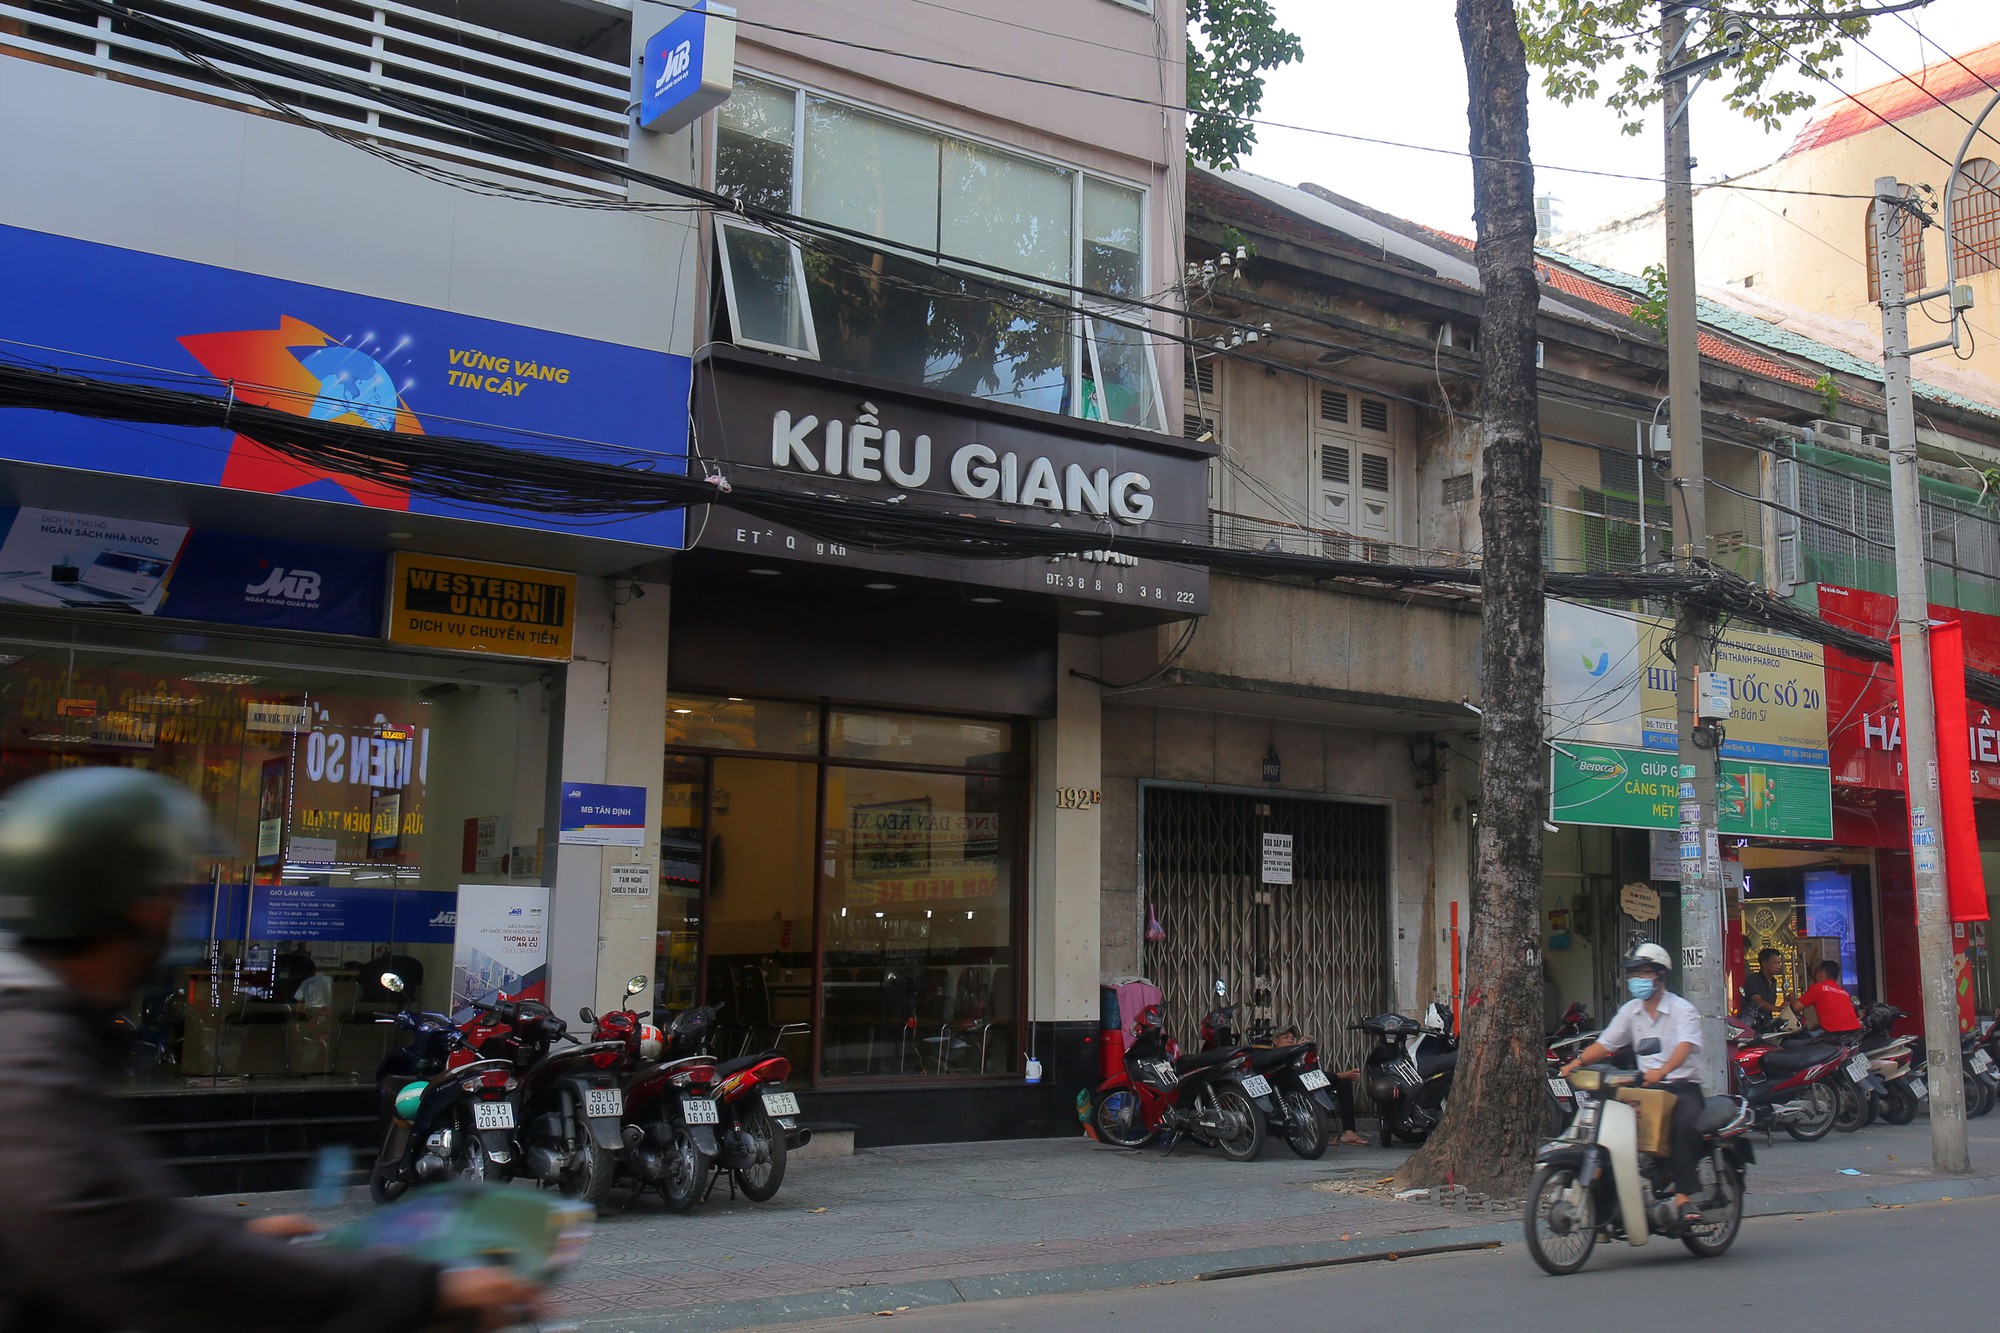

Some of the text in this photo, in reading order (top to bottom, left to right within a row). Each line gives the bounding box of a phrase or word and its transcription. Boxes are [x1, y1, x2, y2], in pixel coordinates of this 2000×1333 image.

[656, 40, 691, 89] MB
[449, 349, 570, 384] VỮNG VÀNG
[448, 370, 528, 396] TIN CẬY
[772, 401, 1155, 525] KIỀU GIANG
[41, 515, 61, 524] DỊCH
[64, 518, 75, 526] VỤ
[40, 524, 160, 546] NGÂN SÁCH NHÀ NƯỚC
[245, 567, 321, 600] MB
[409, 569, 540, 603] WESTERN
[1176, 591, 1195, 604] 222
[451, 594, 539, 623] UNION
[410, 617, 443, 633] DỊCH
[447, 622, 466, 637] VỤ
[470, 624, 525, 642] CHUYỂN
[1778, 645, 1790, 657] BẾN
[1728, 652, 1780, 668] THÀNH PHARCO
[1774, 678, 1798, 708] SỐ
[1803, 687, 1820, 710] 20
[1740, 707, 1757, 721] Bán
[1656, 719, 1673, 731] TUYẾT
[1579, 760, 1614, 773] Berocca
[1641, 760, 1668, 777] GIÚP
[1625, 780, 1658, 797] CĂNG
[581, 806, 631, 817] MB TÂN ĐỊNH
[1652, 803, 1675, 820] MỆT
[284, 889, 298, 897] LÀM
[589, 1103, 620, 1115] 986.97
[771, 1104, 795, 1114] 4073
[478, 1115, 511, 1128] 208.11
[687, 1112, 716, 1123] 161.87
